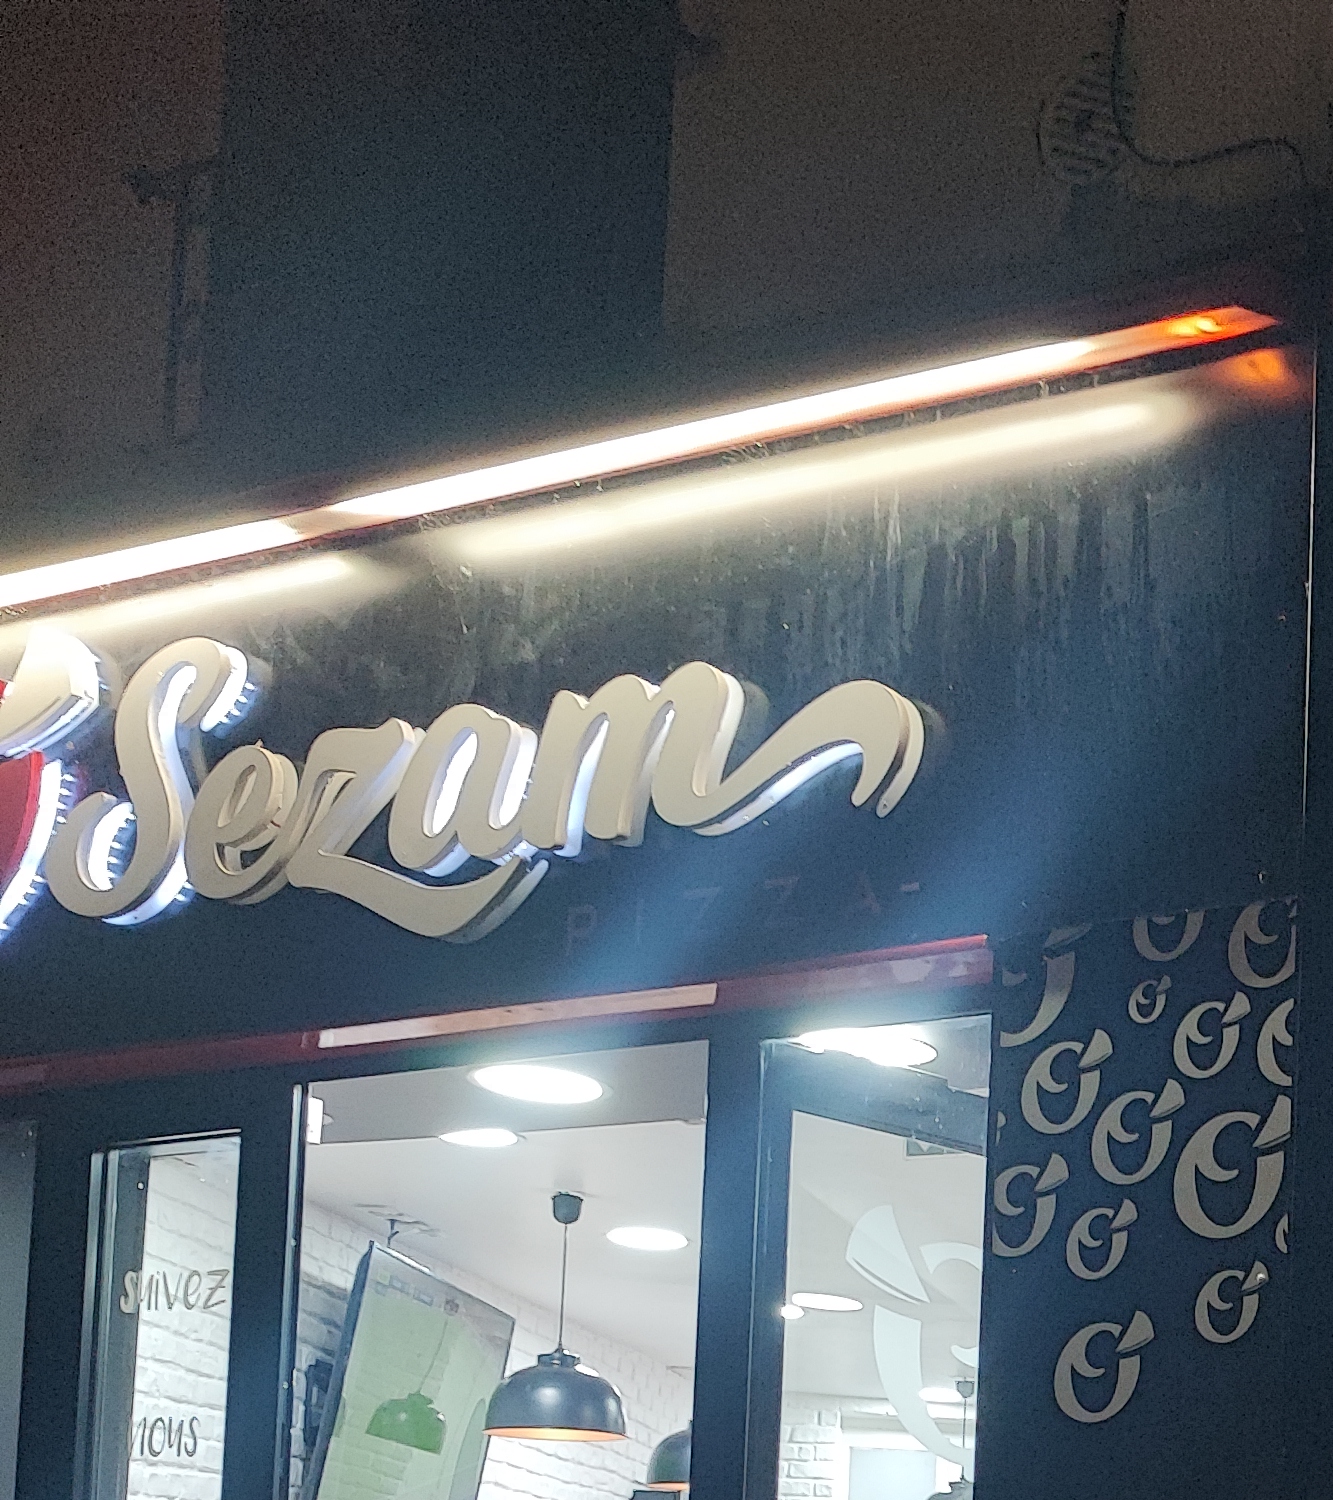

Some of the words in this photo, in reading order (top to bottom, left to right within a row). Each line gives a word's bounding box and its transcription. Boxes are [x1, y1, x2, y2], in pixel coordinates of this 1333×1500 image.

[48, 638, 923, 942] Sezam
[120, 1268, 230, 1314] suivez
[127, 1414, 199, 1458] nous
